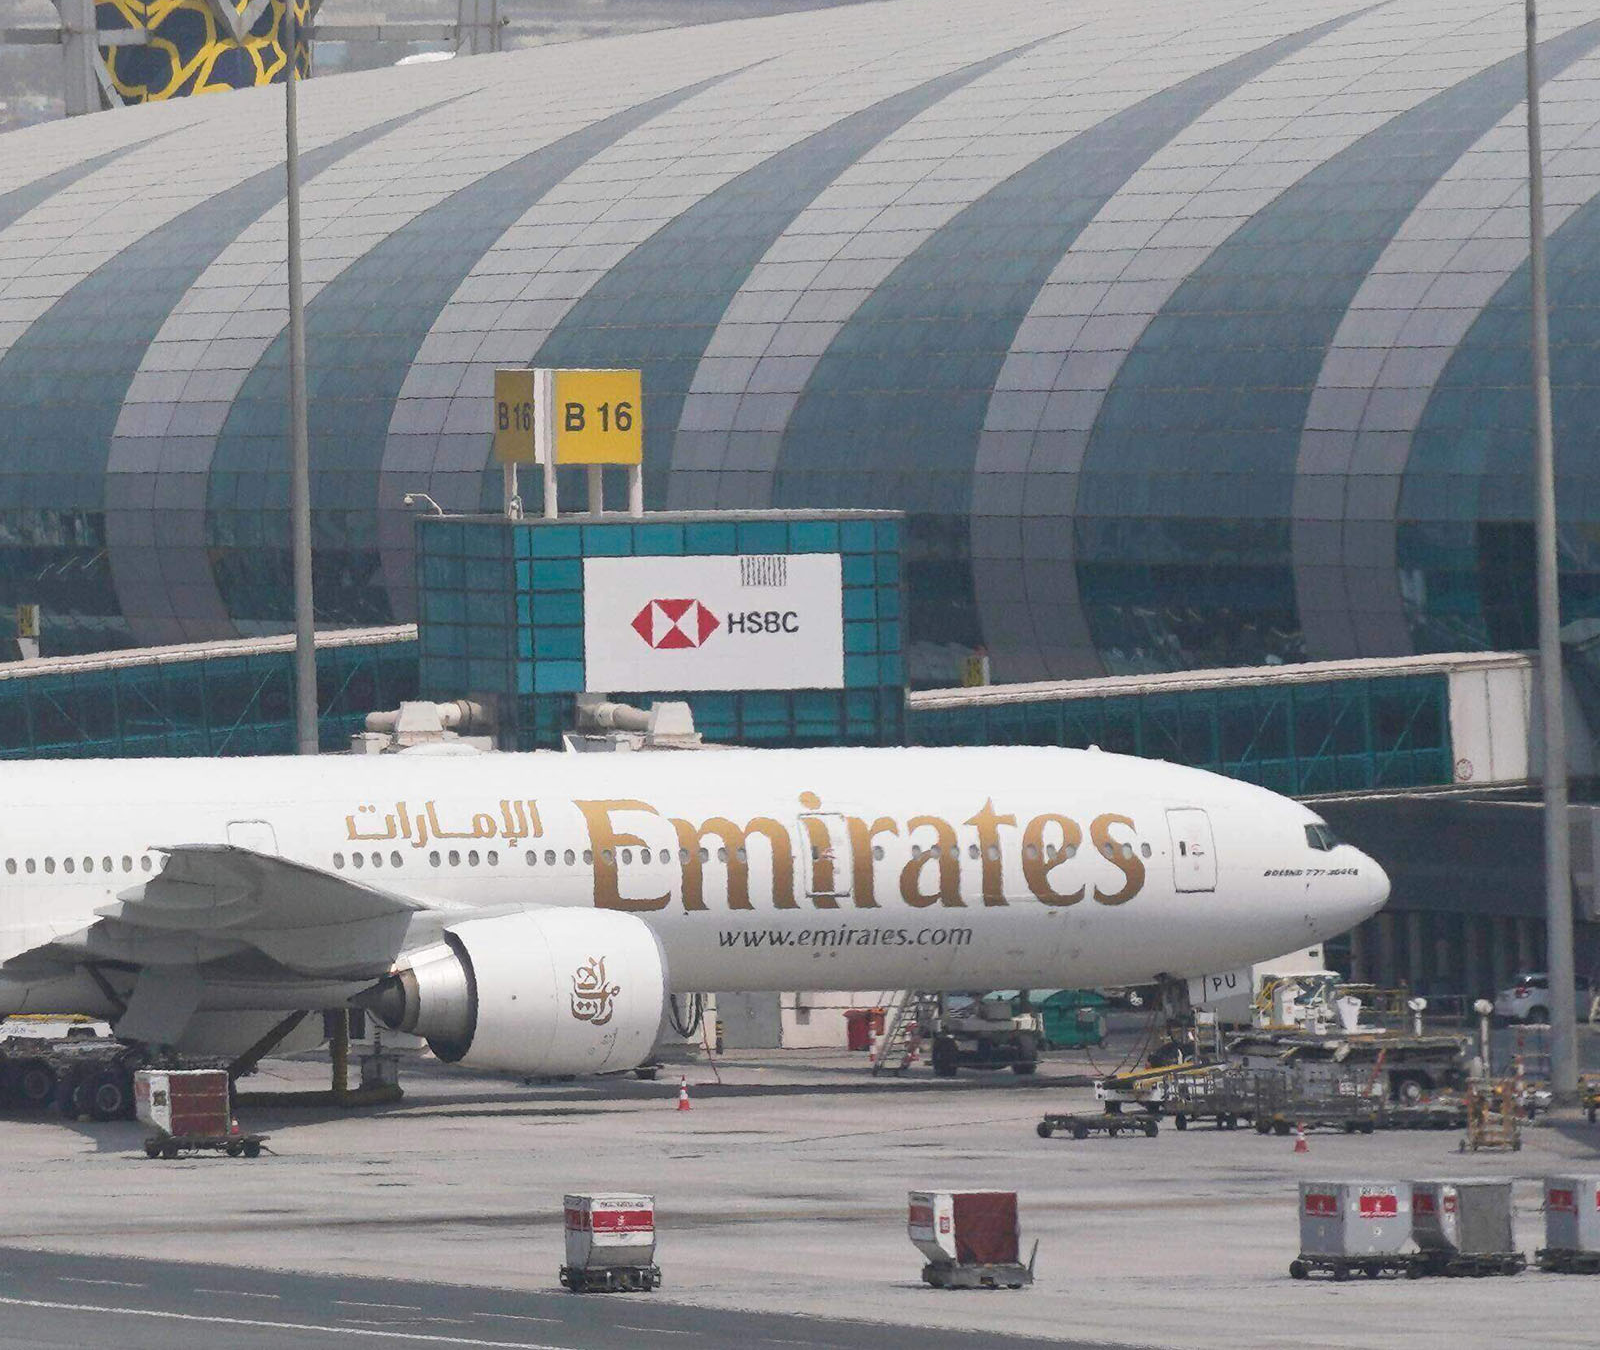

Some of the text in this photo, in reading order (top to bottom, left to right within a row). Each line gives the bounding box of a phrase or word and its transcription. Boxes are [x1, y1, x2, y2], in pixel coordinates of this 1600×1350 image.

[565, 401, 633, 432] B 16
[727, 611, 800, 634] HSBC
[346, 798, 543, 848] الإمارات
[573, 790, 1146, 912] Emirates
[718, 923, 973, 948] www.emirates.com
[1212, 972, 1237, 992] PU
